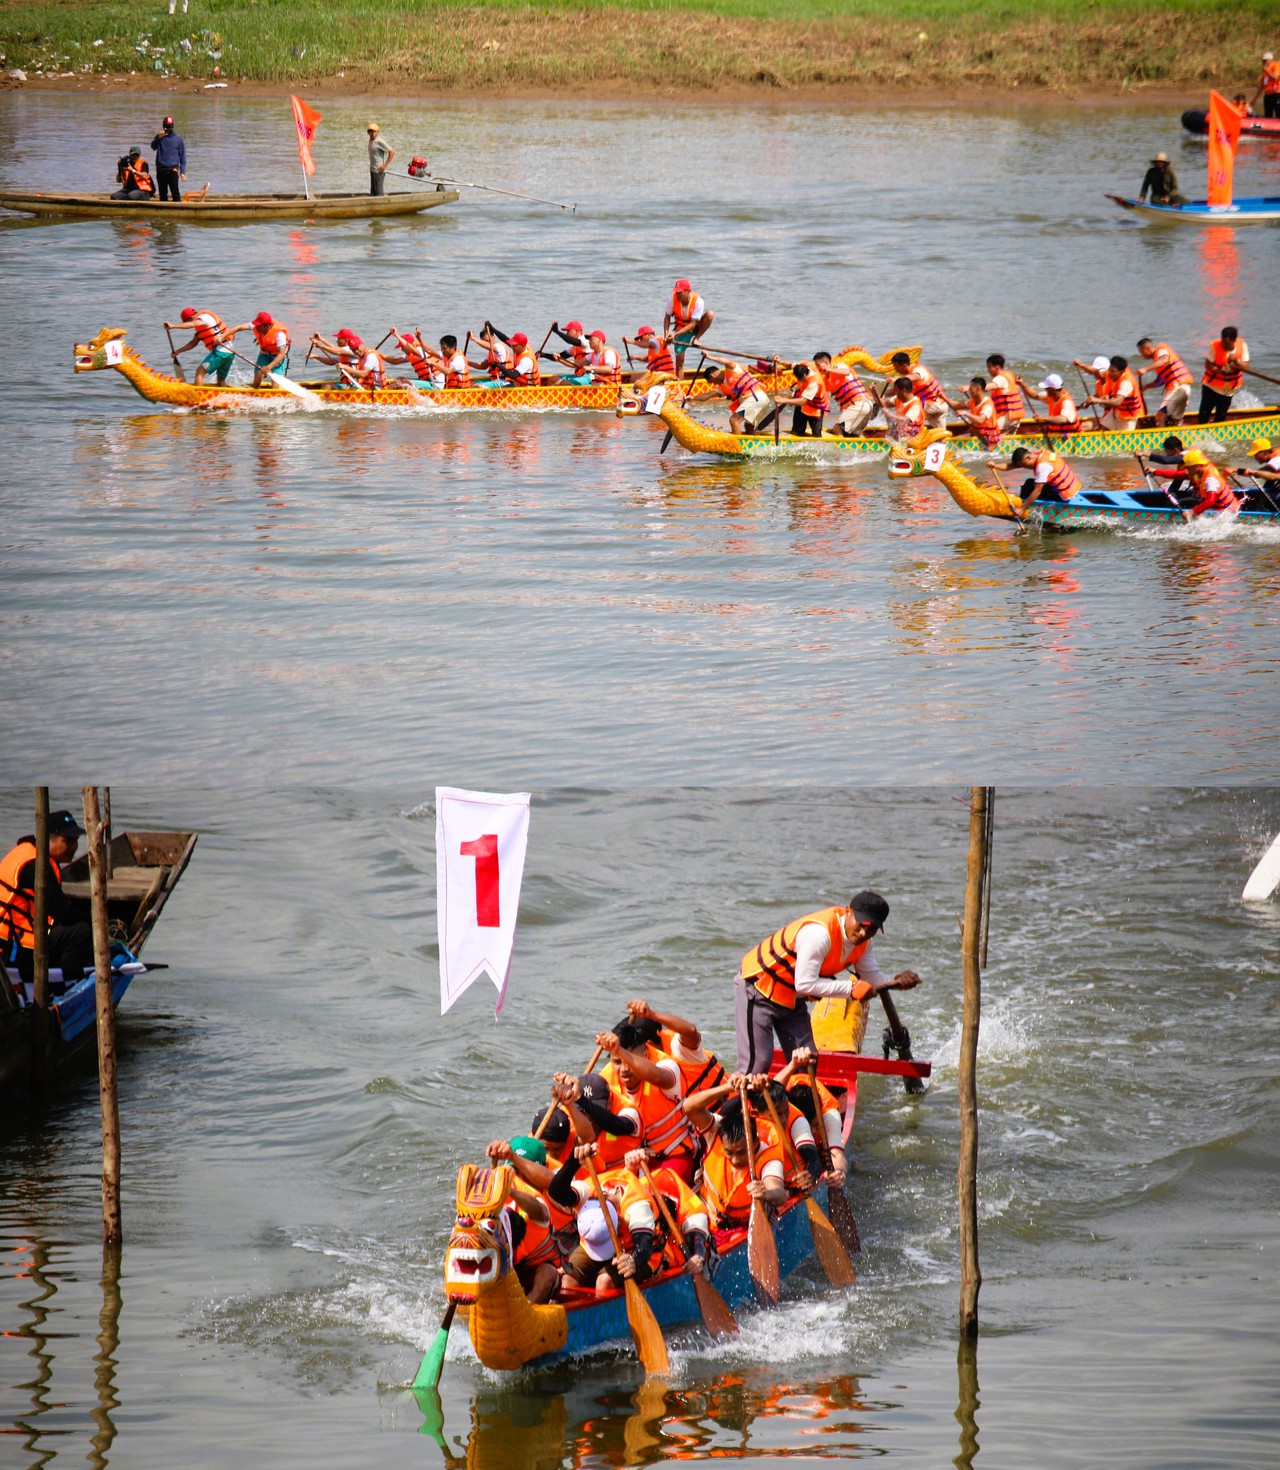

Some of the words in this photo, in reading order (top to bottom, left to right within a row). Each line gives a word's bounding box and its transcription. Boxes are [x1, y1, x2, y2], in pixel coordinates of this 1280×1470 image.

[111, 345, 119, 359] 4
[931, 449, 940, 464] 3
[460, 833, 500, 928] 1
[583, 1085, 593, 1098] NY
